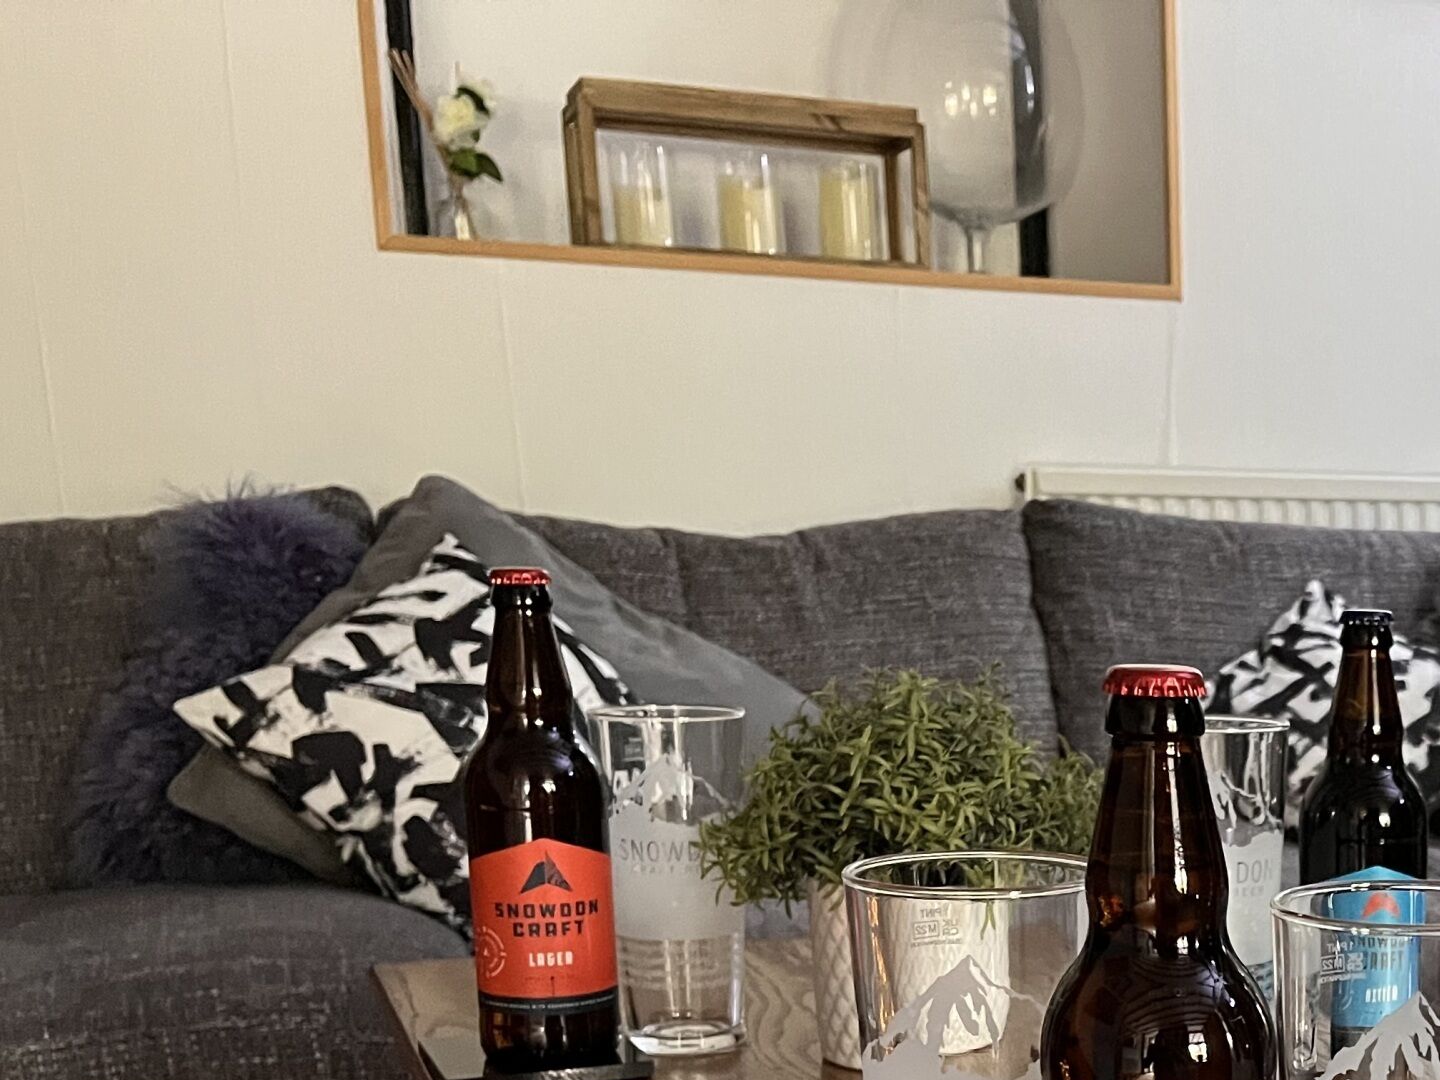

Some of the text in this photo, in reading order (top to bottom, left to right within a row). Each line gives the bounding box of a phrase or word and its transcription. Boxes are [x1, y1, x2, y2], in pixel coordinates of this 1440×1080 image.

[494, 899, 599, 918] SNOWDON
[513, 920, 584, 938] CRAFT
[529, 951, 574, 967] LAGER
